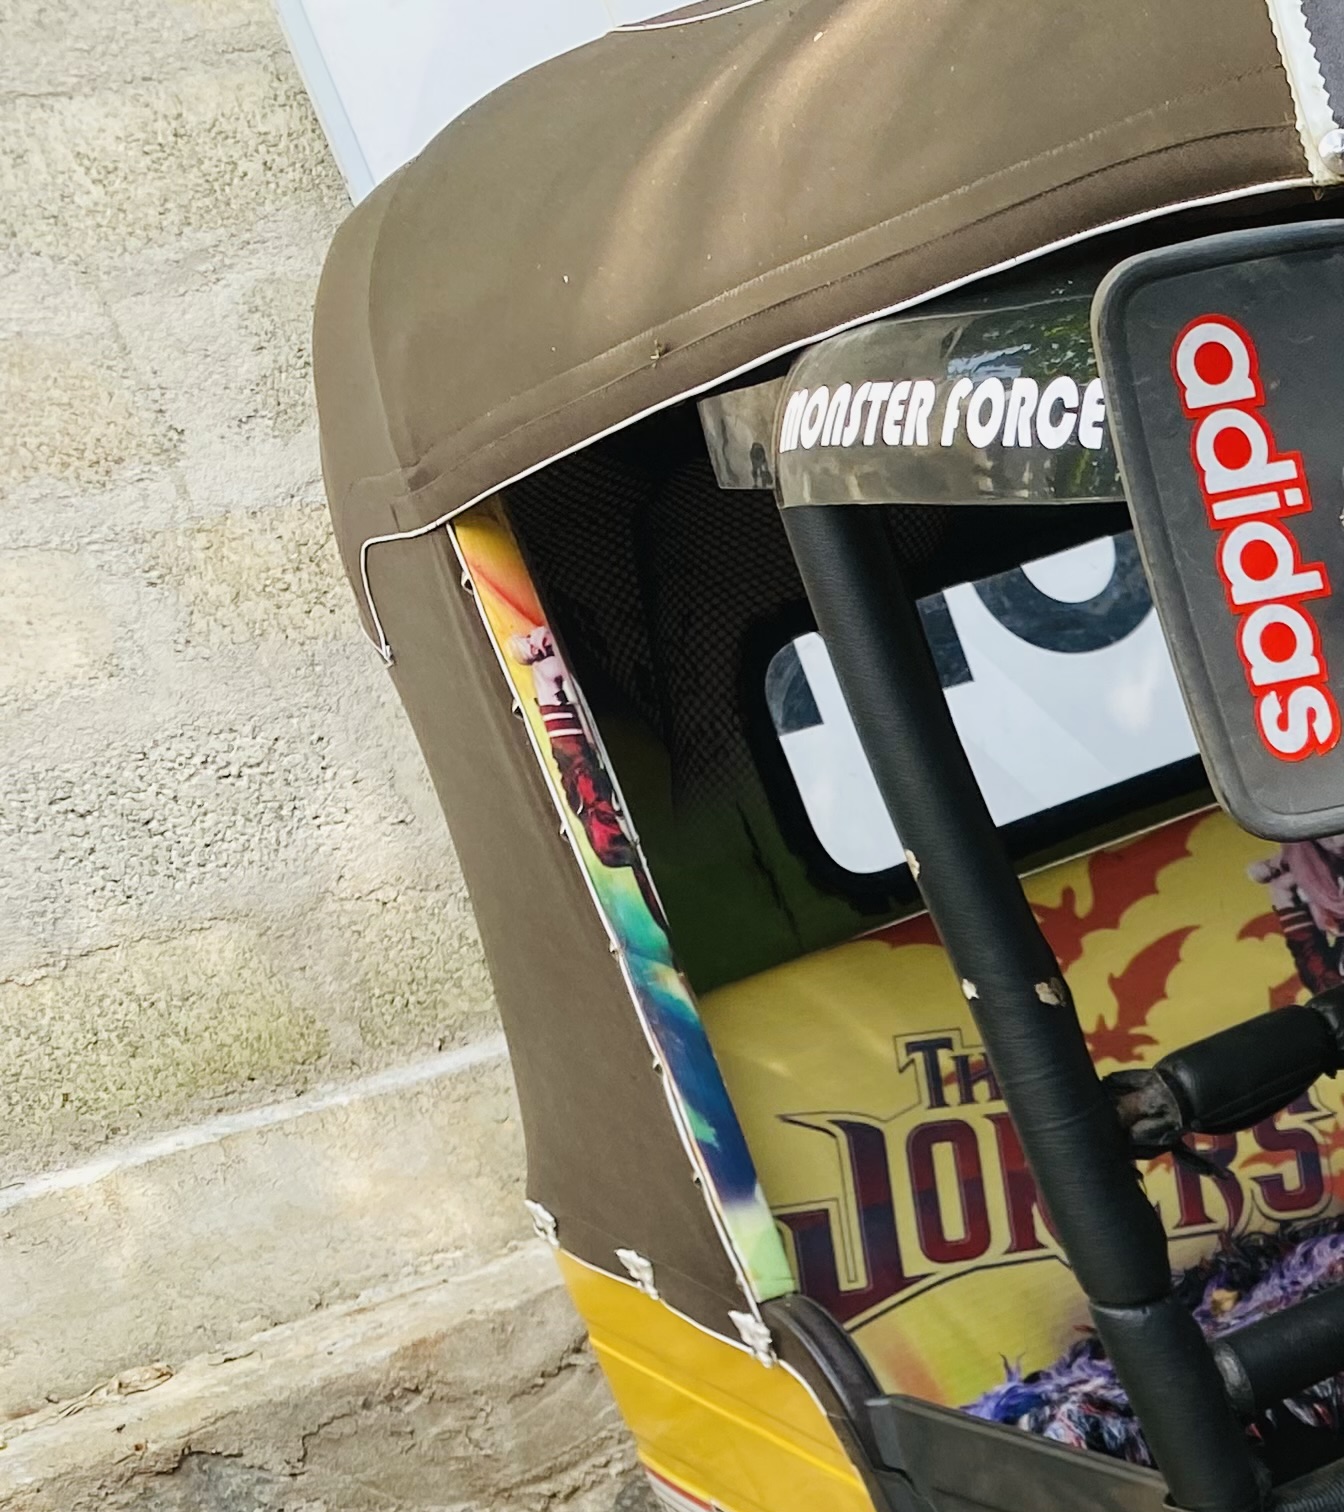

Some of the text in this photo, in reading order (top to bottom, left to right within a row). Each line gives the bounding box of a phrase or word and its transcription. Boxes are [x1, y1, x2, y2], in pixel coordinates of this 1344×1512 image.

[778, 375, 1107, 454] MONSTER FORCE
[1173, 316, 1336, 758] adidas
[905, 1037, 1004, 1108] TH
[780, 1092, 1326, 1323] JORS
